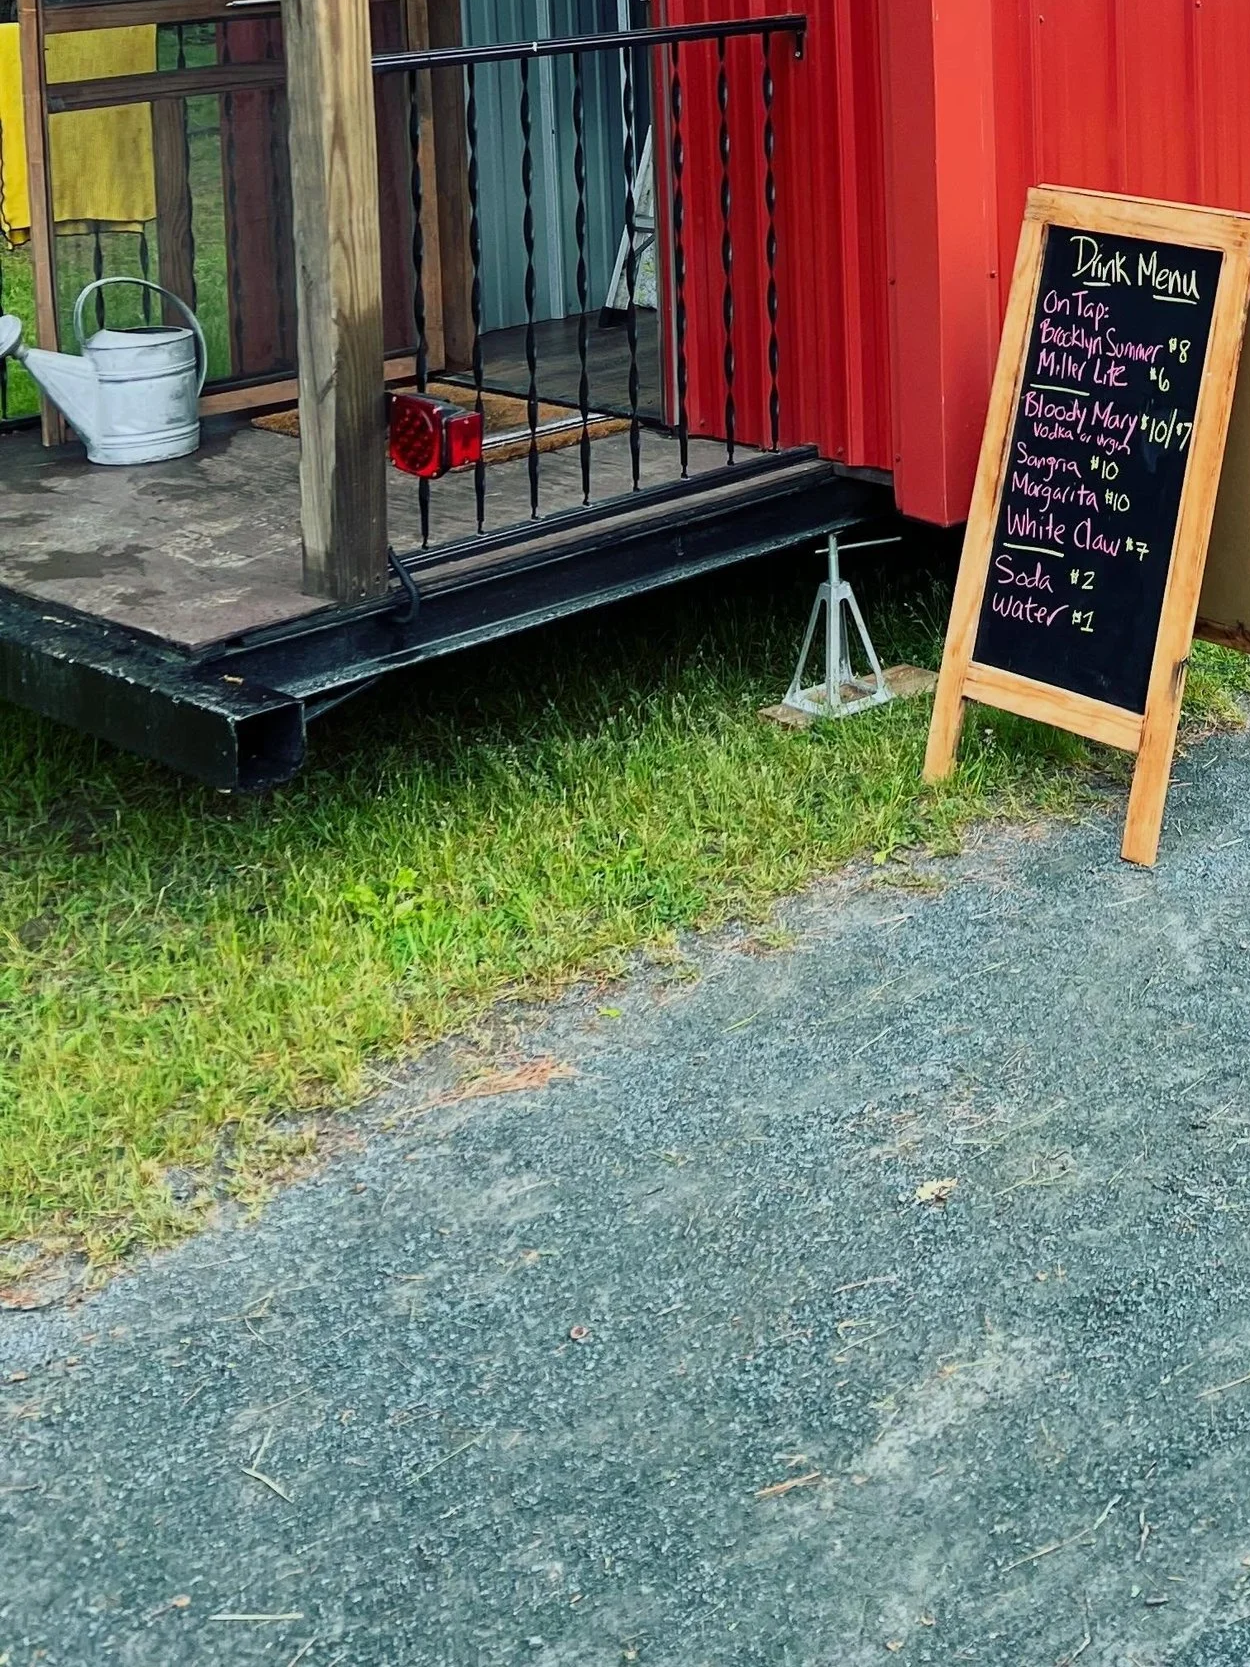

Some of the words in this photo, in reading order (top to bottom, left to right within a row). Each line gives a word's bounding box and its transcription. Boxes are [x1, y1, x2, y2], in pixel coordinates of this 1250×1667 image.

[1070, 236, 1131, 286] Drink
[1138, 251, 1200, 300] Menu
[1043, 290, 1070, 315] On
[1072, 290, 1110, 331] Tap:
[1040, 318, 1102, 360] Brooklyn
[1106, 327, 1164, 364] Summer
[1037, 348, 1087, 382] Miller
[1093, 358, 1128, 387] Lite
[1023, 391, 1087, 434] Bloody
[1091, 400, 1138, 448] Mary
[1033, 422, 1074, 441] Vodka
[1080, 434, 1091, 443] or
[1016, 441, 1082, 482] Sangria
[1011, 471, 1099, 513] Margarita
[1007, 504, 1066, 545] White
[1073, 518, 1121, 557] Claw
[995, 554, 1054, 593] Soda
